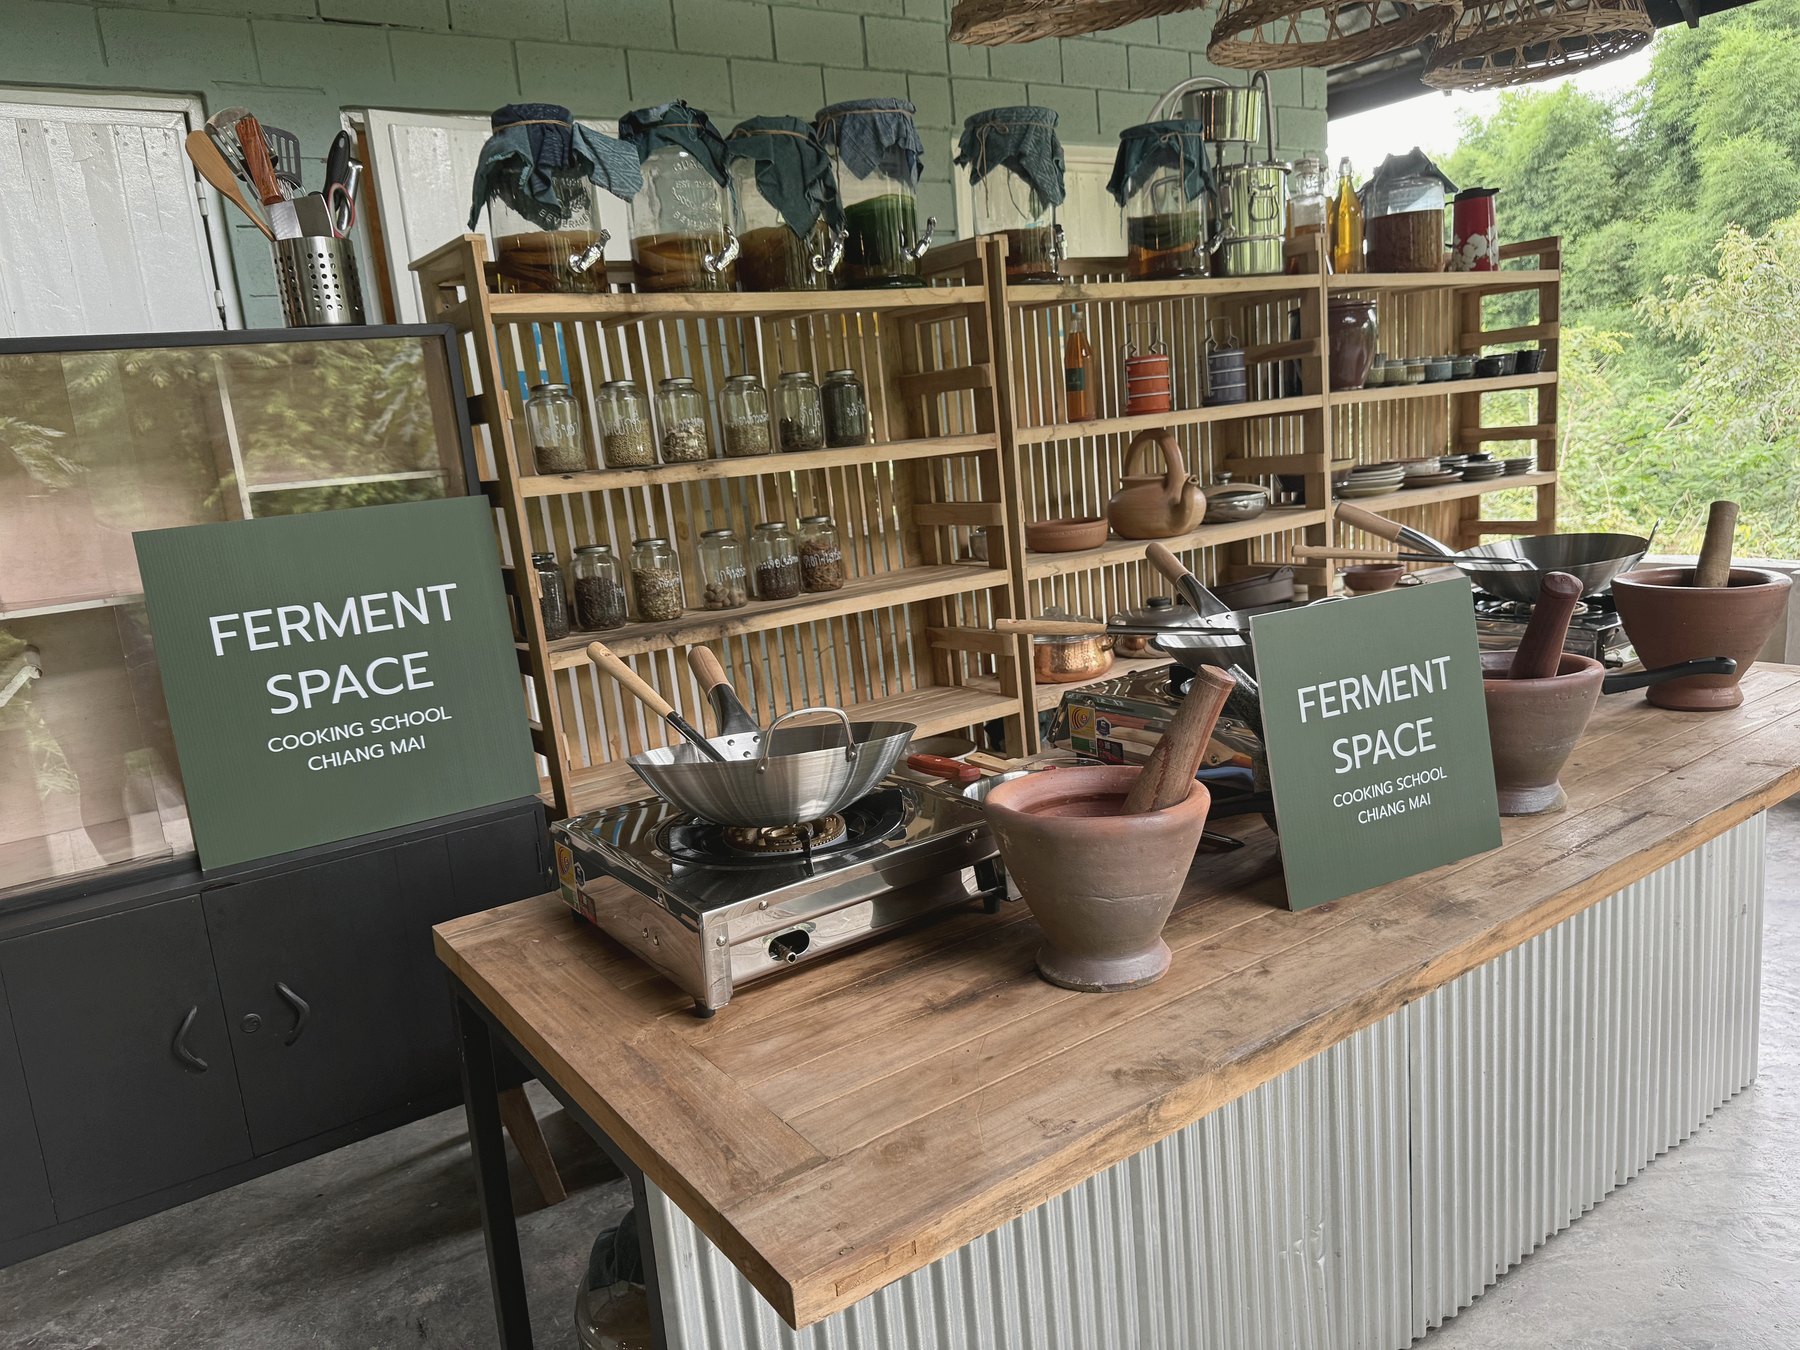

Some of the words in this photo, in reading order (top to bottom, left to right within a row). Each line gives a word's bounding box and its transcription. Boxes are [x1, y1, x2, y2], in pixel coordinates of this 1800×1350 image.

[209, 583, 457, 656] FERMENT
[267, 651, 435, 714] SPACE
[1297, 656, 1451, 723] FERMENT
[268, 722, 364, 752] COOKING
[371, 706, 453, 734] SCHOOL
[308, 743, 384, 771] CHIANG
[389, 733, 427, 755] MAI
[1332, 717, 1437, 774] SPACE
[1333, 780, 1394, 808] COOKING
[1397, 766, 1448, 791] SCHOOL
[1357, 799, 1406, 824] CHIANG
[1409, 792, 1431, 810] MAI
